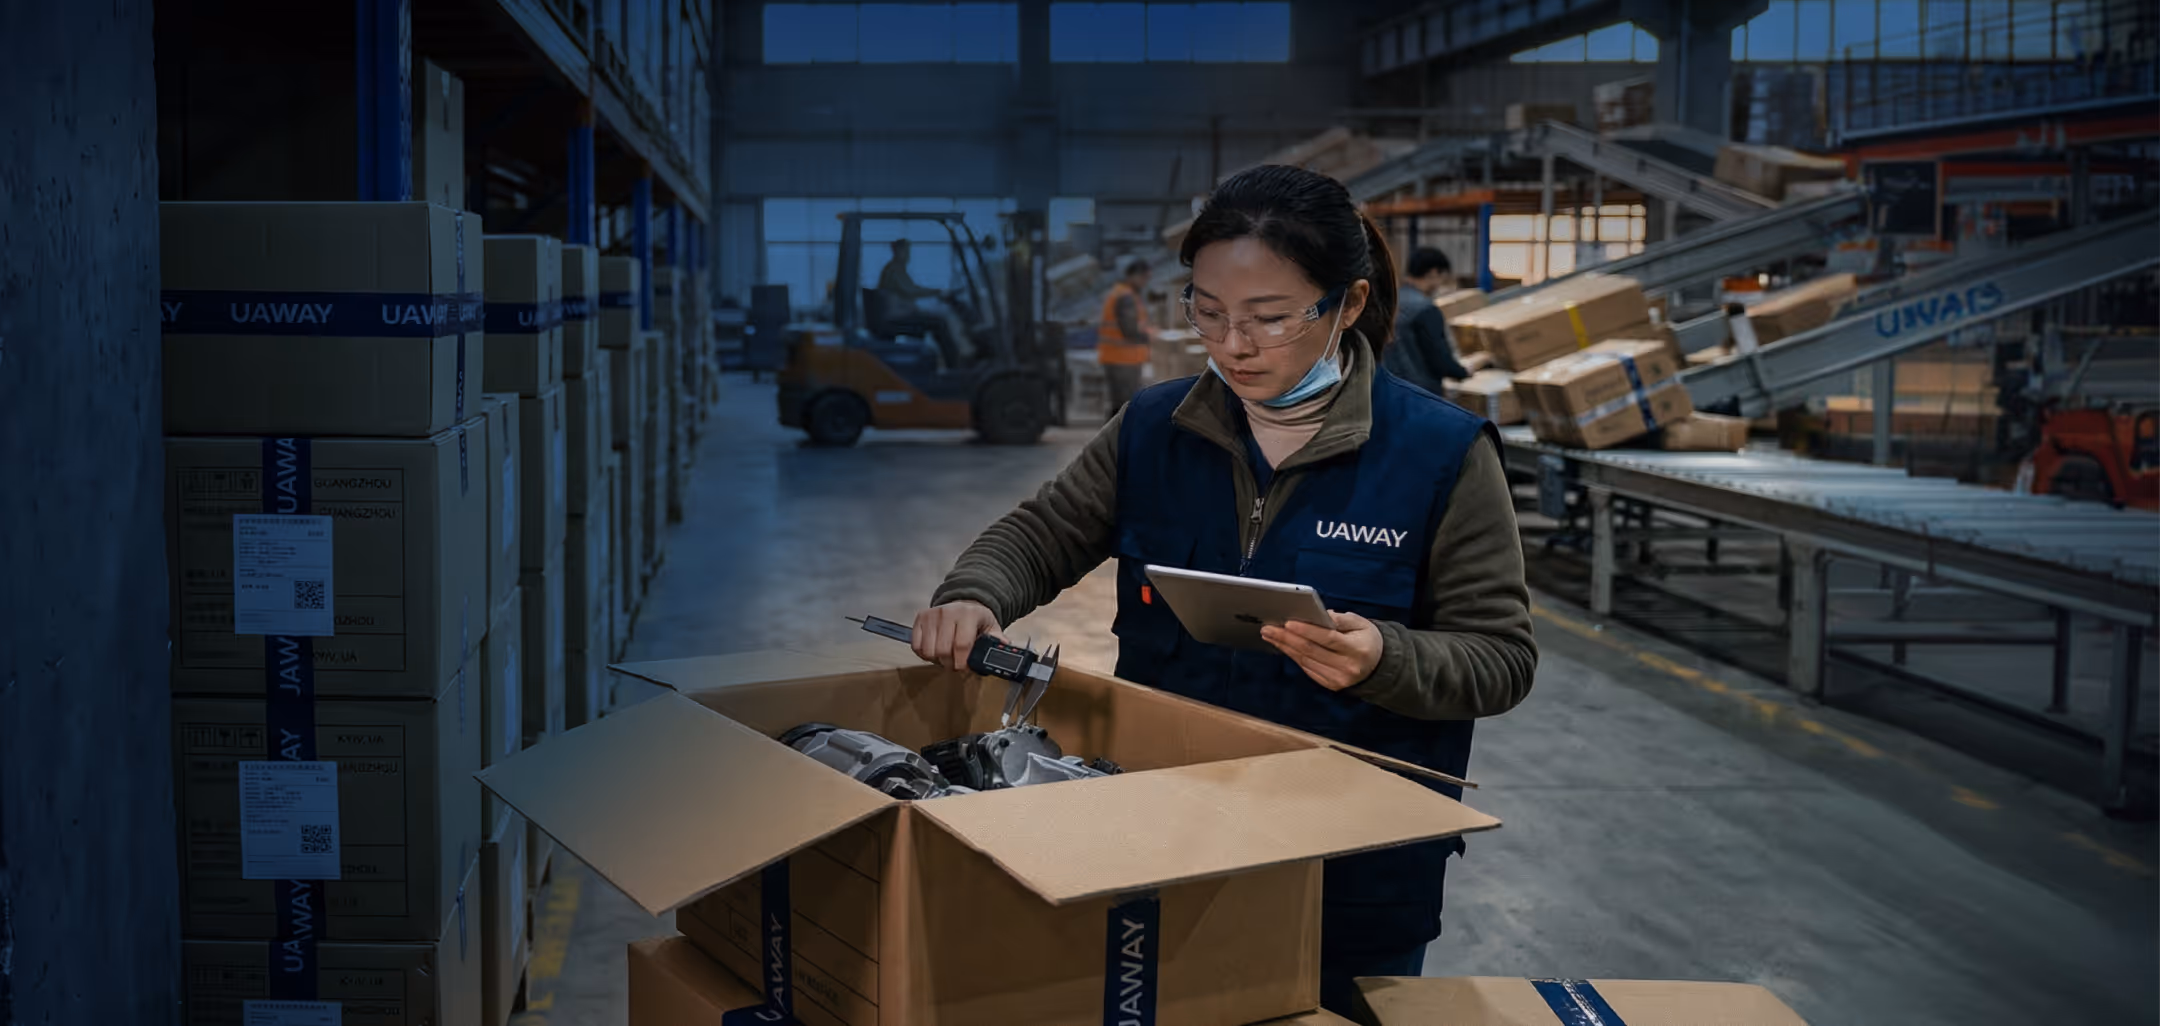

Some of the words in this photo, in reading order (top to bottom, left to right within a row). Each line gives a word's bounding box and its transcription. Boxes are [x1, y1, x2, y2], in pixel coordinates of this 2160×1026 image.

[230, 302, 334, 324] UAWAY
[314, 477, 392, 490] GUANGZHOU
[1315, 519, 1409, 548] UAWAY
[281, 879, 314, 974] UAWAY
